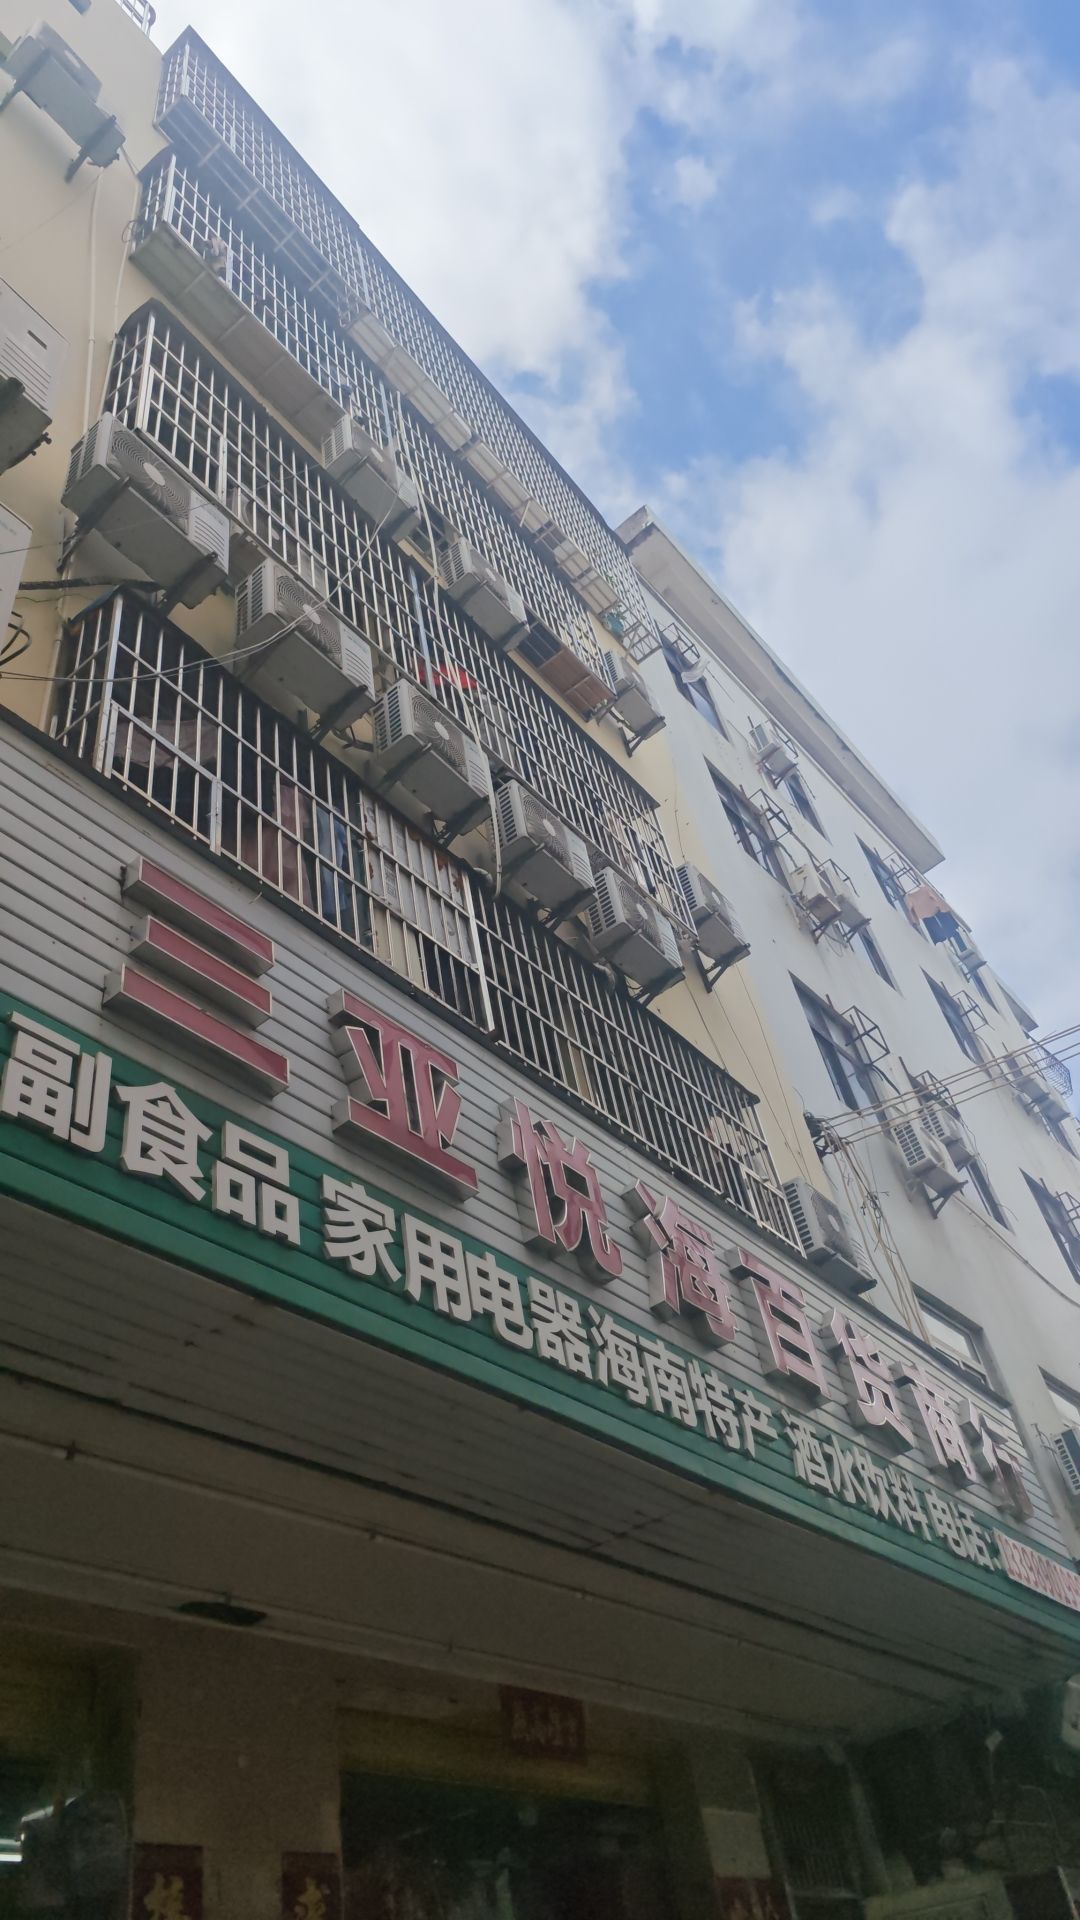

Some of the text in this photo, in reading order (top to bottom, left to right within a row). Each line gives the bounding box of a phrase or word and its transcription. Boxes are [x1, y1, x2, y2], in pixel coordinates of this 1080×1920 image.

[1, 1010, 301, 1247] 副食品
[103, 855, 1034, 1521] 三亚悦海百货商行
